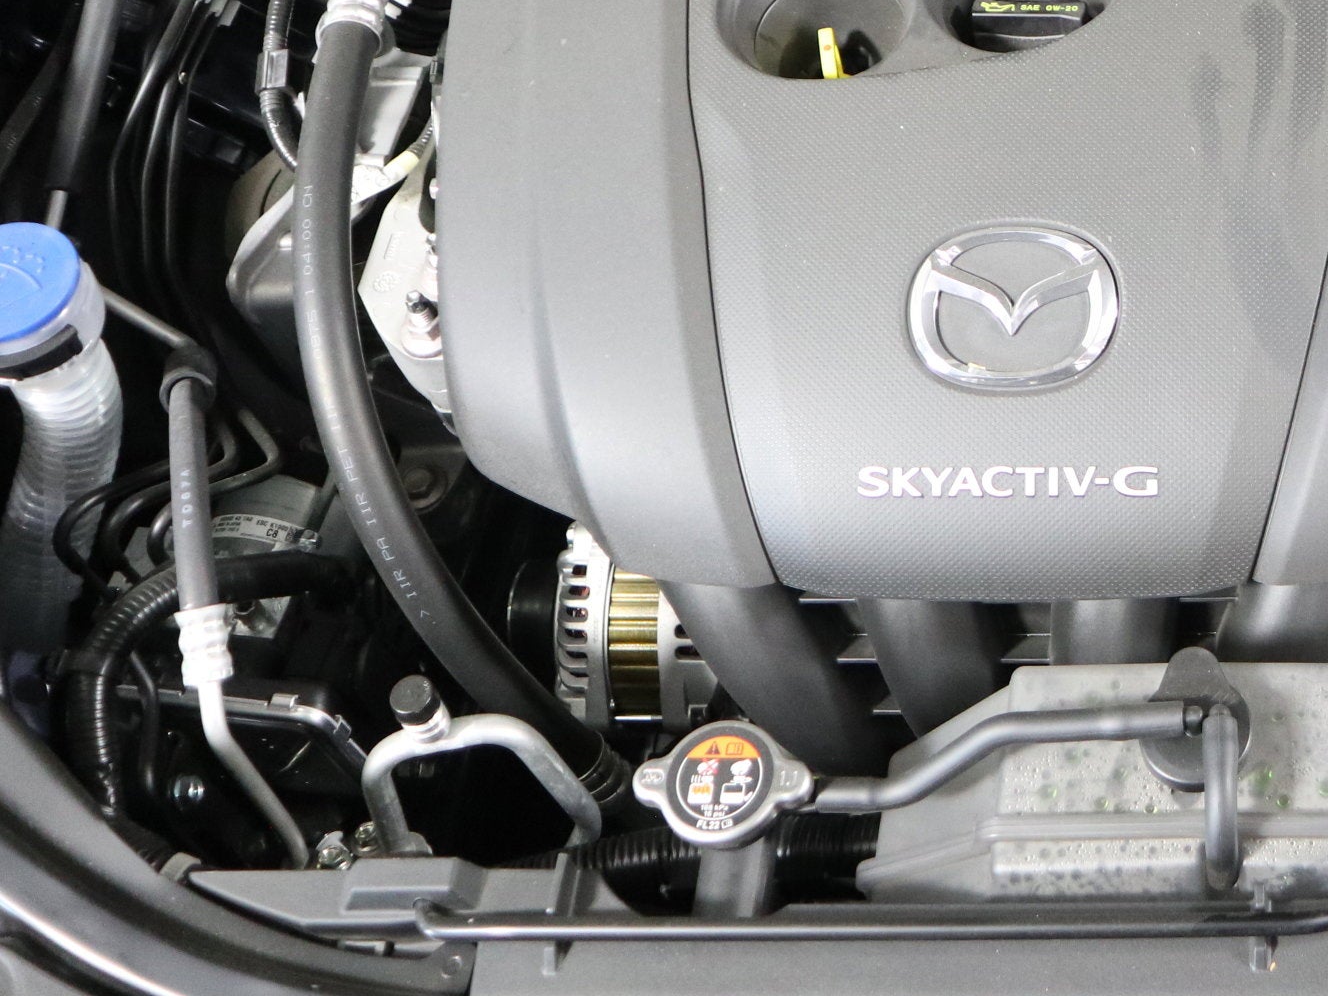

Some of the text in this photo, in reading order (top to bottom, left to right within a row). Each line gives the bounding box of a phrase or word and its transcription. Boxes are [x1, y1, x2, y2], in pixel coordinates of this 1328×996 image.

[857, 465, 1159, 498] SKYACTIV-G
[779, 770, 798, 787] 1.1
[696, 819, 720, 830] FL22
